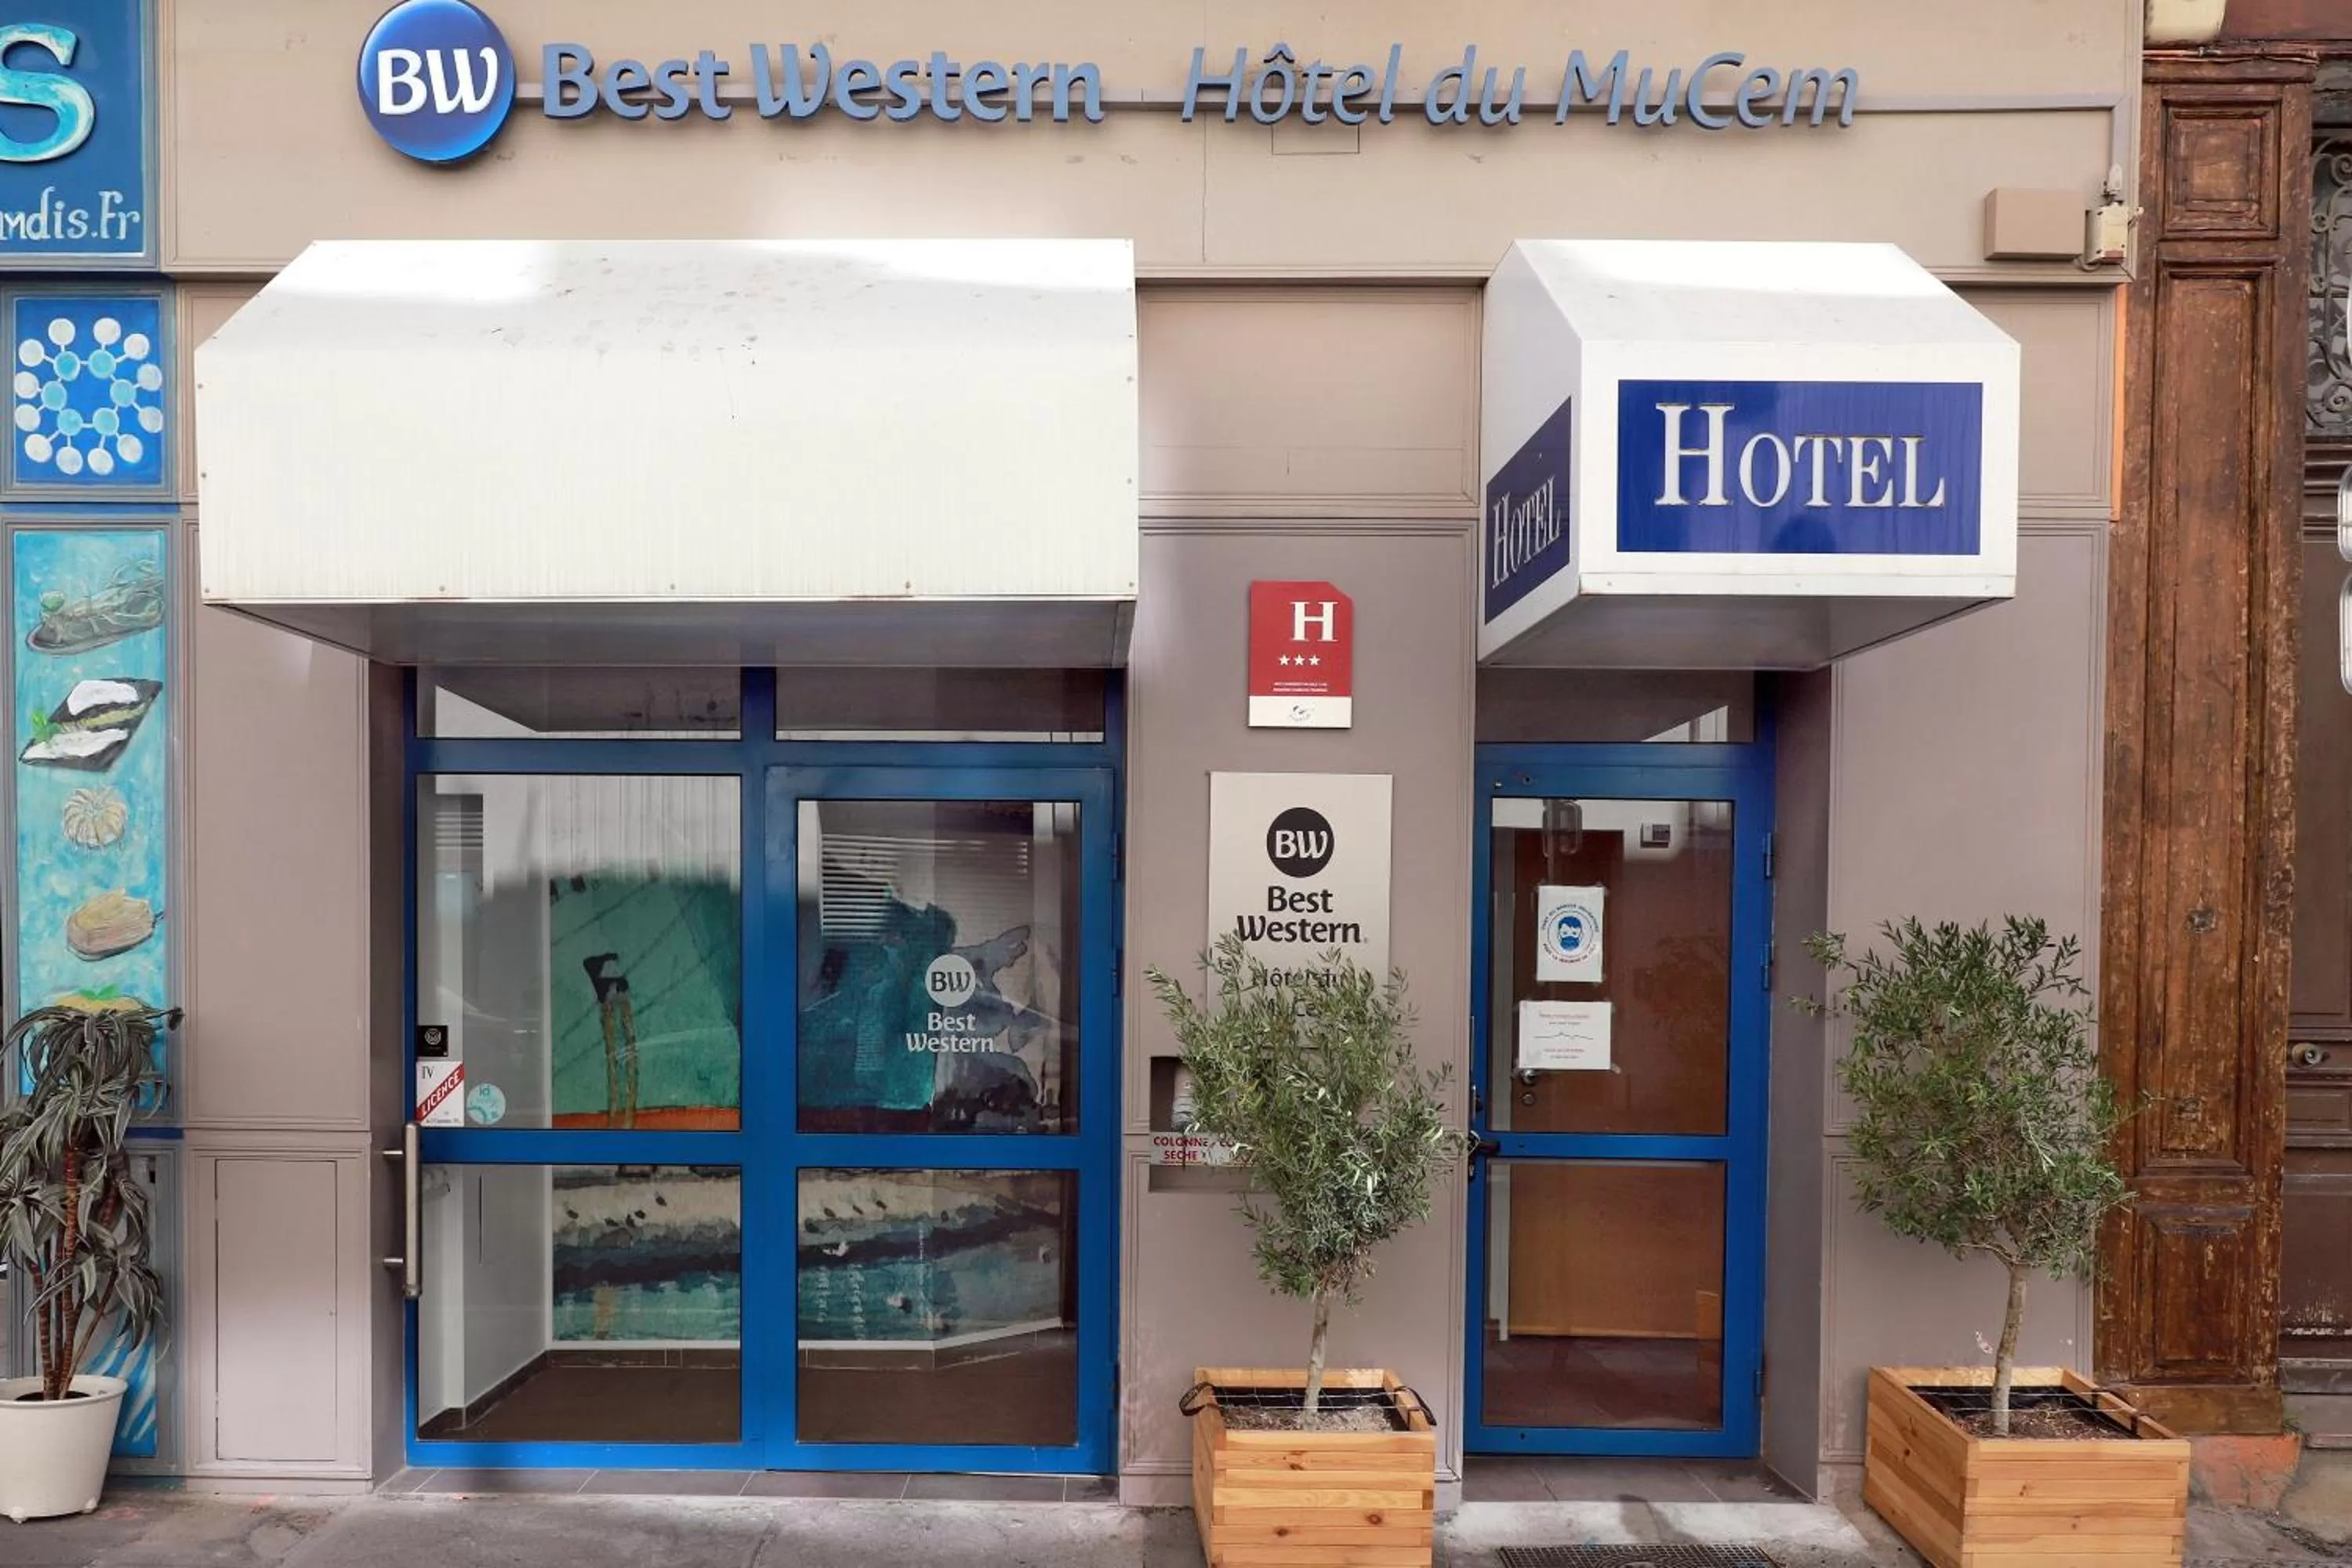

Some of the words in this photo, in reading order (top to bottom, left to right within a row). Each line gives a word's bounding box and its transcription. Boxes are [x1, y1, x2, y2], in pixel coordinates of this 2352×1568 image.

[0, 24, 95, 162] S
[377, 47, 498, 115] BW
[542, 43, 732, 122] Best
[750, 43, 1105, 122] Western
[1181, 42, 1402, 125] Hôtel
[1425, 44, 1526, 127] du
[1555, 49, 1859, 129] MuCem
[1655, 402, 1945, 507] HOTEL
[1492, 475, 1562, 590] HOTEL
[1290, 601, 1339, 642] H
[1276, 830, 1328, 858] BW
[1268, 885, 1333, 913] Best
[1236, 915, 1361, 943] Western
[931, 971, 971, 992] BW
[1253, 967, 1310, 987] Hôtl
[927, 1012, 976, 1032] Best
[906, 1033, 994, 1053] Western
[422, 1065, 434, 1080] IV
[422, 1070, 460, 1116] LICENCE
